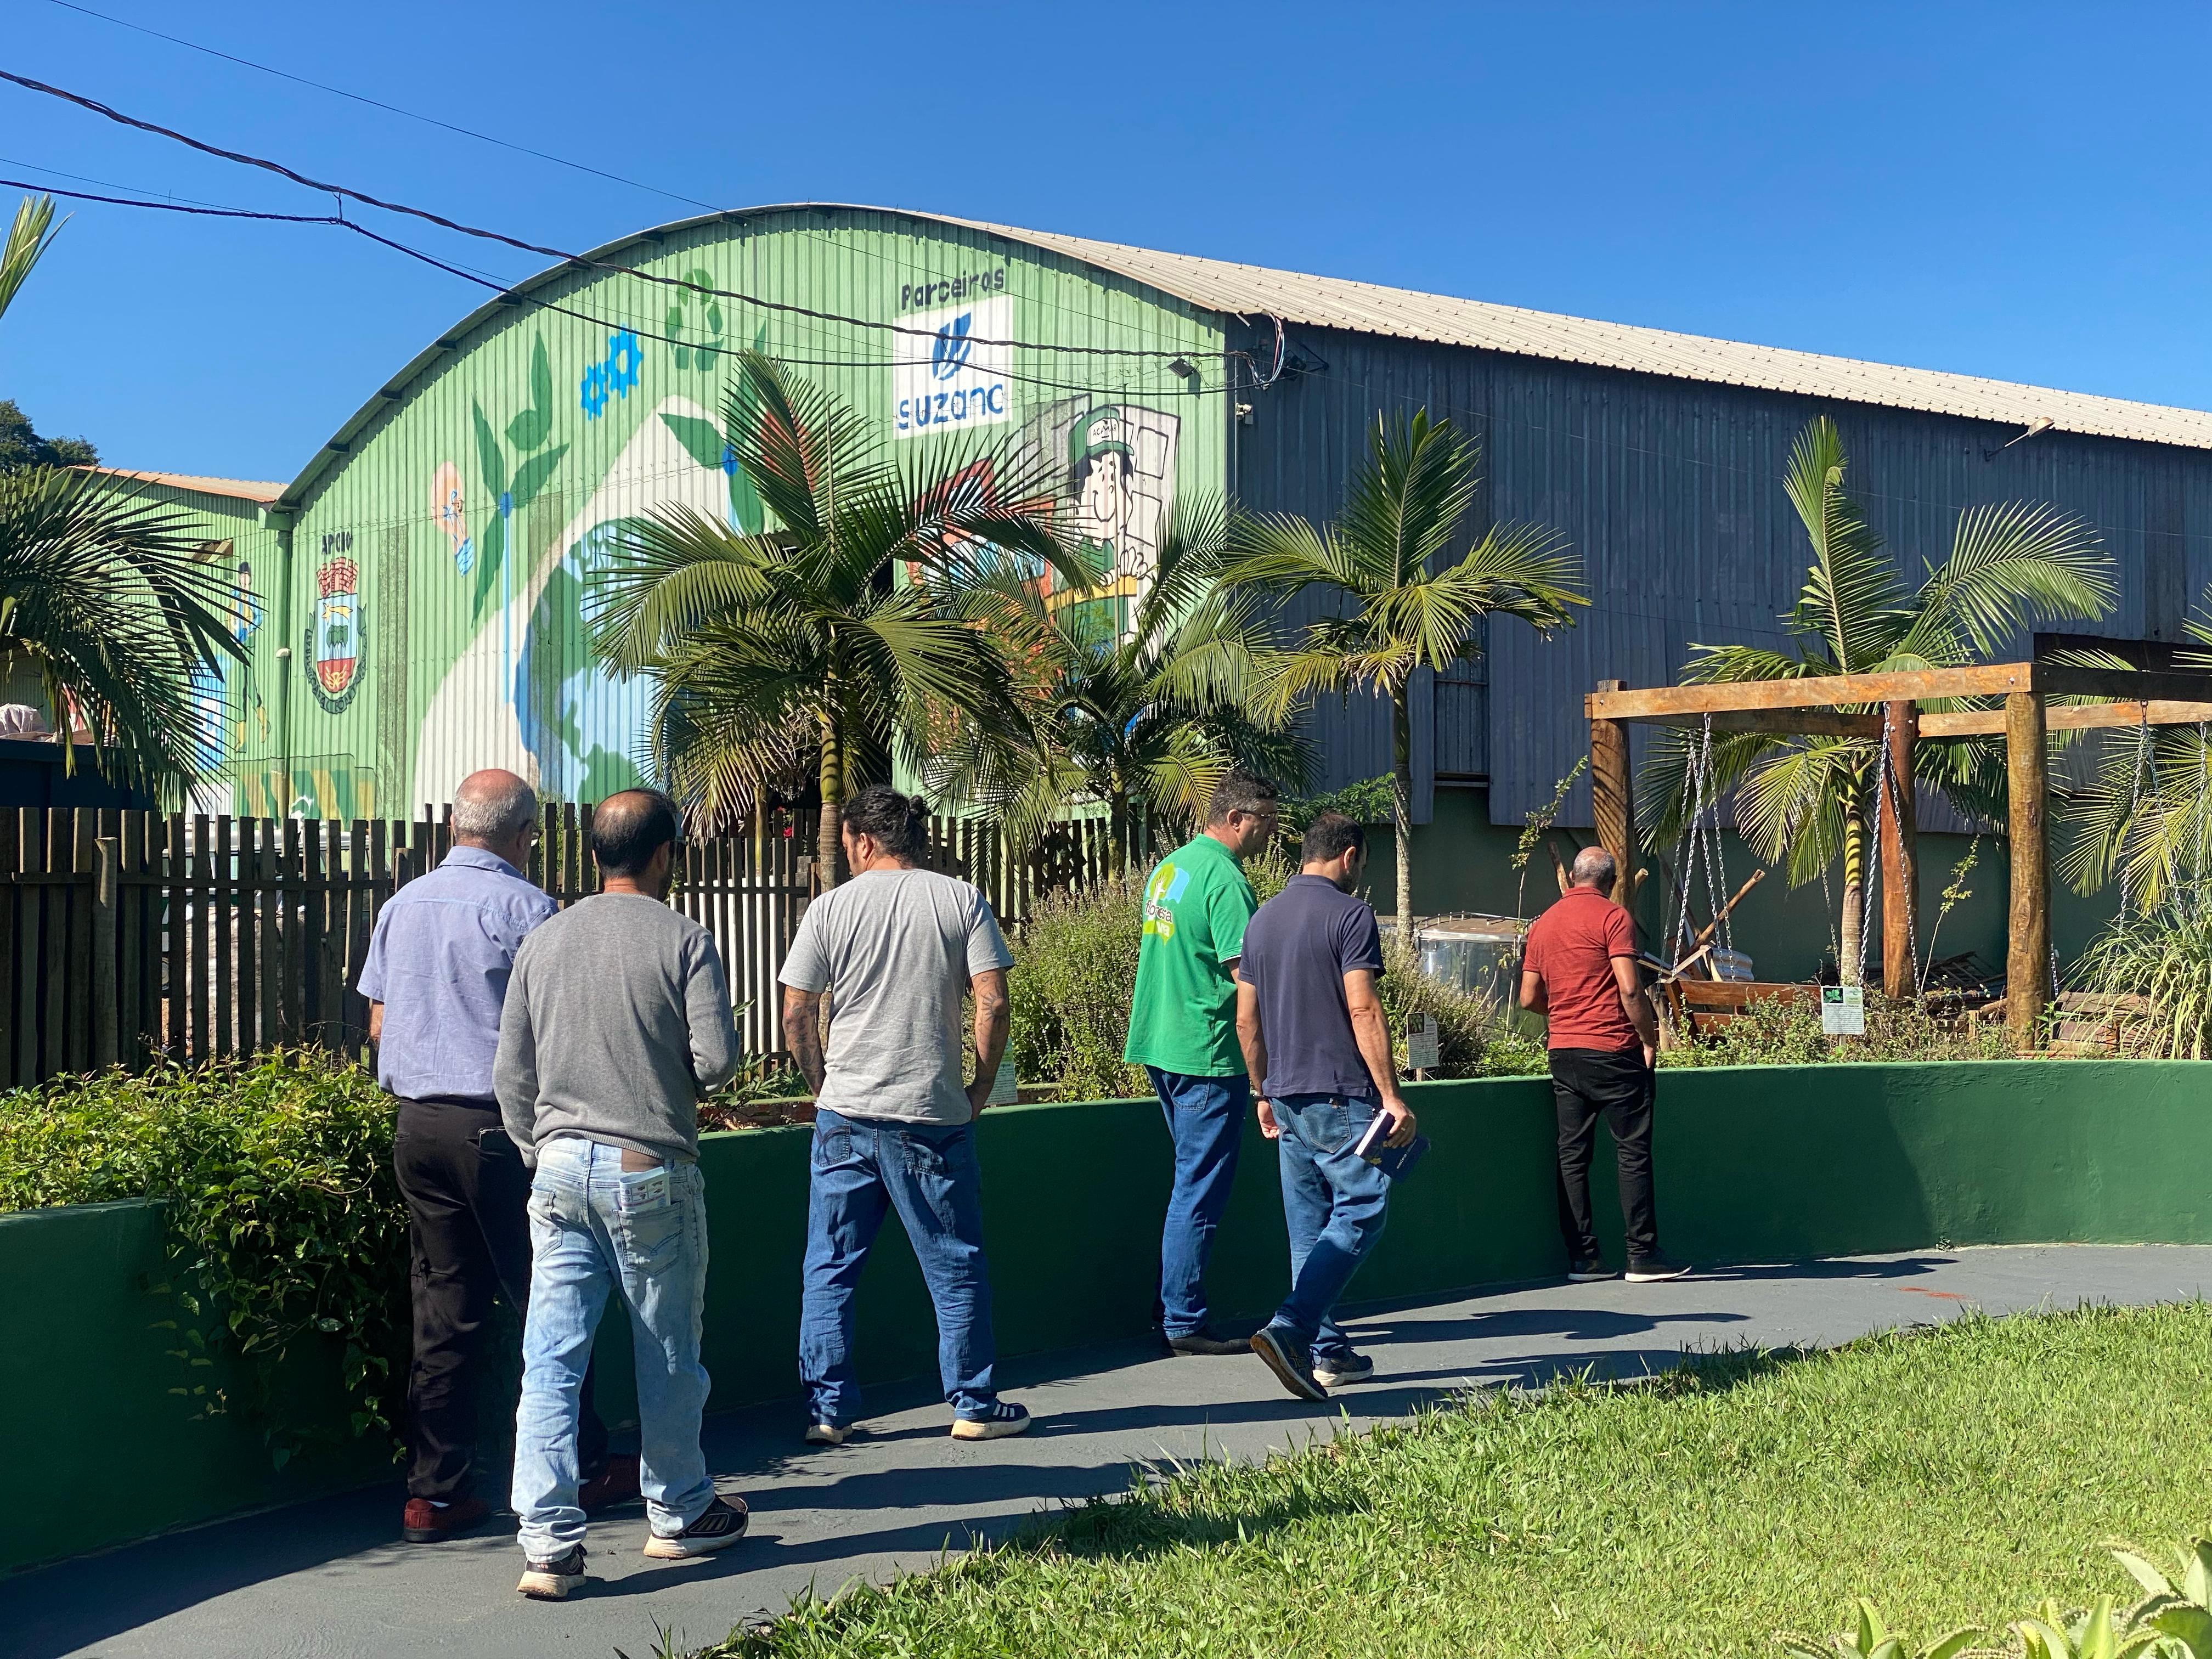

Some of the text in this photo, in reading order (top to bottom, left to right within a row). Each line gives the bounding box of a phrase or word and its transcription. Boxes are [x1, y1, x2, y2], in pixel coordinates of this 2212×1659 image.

[901, 268, 1004, 311] Parceiros
[898, 384, 1003, 430] suzano
[321, 531, 353, 555] APOIO
